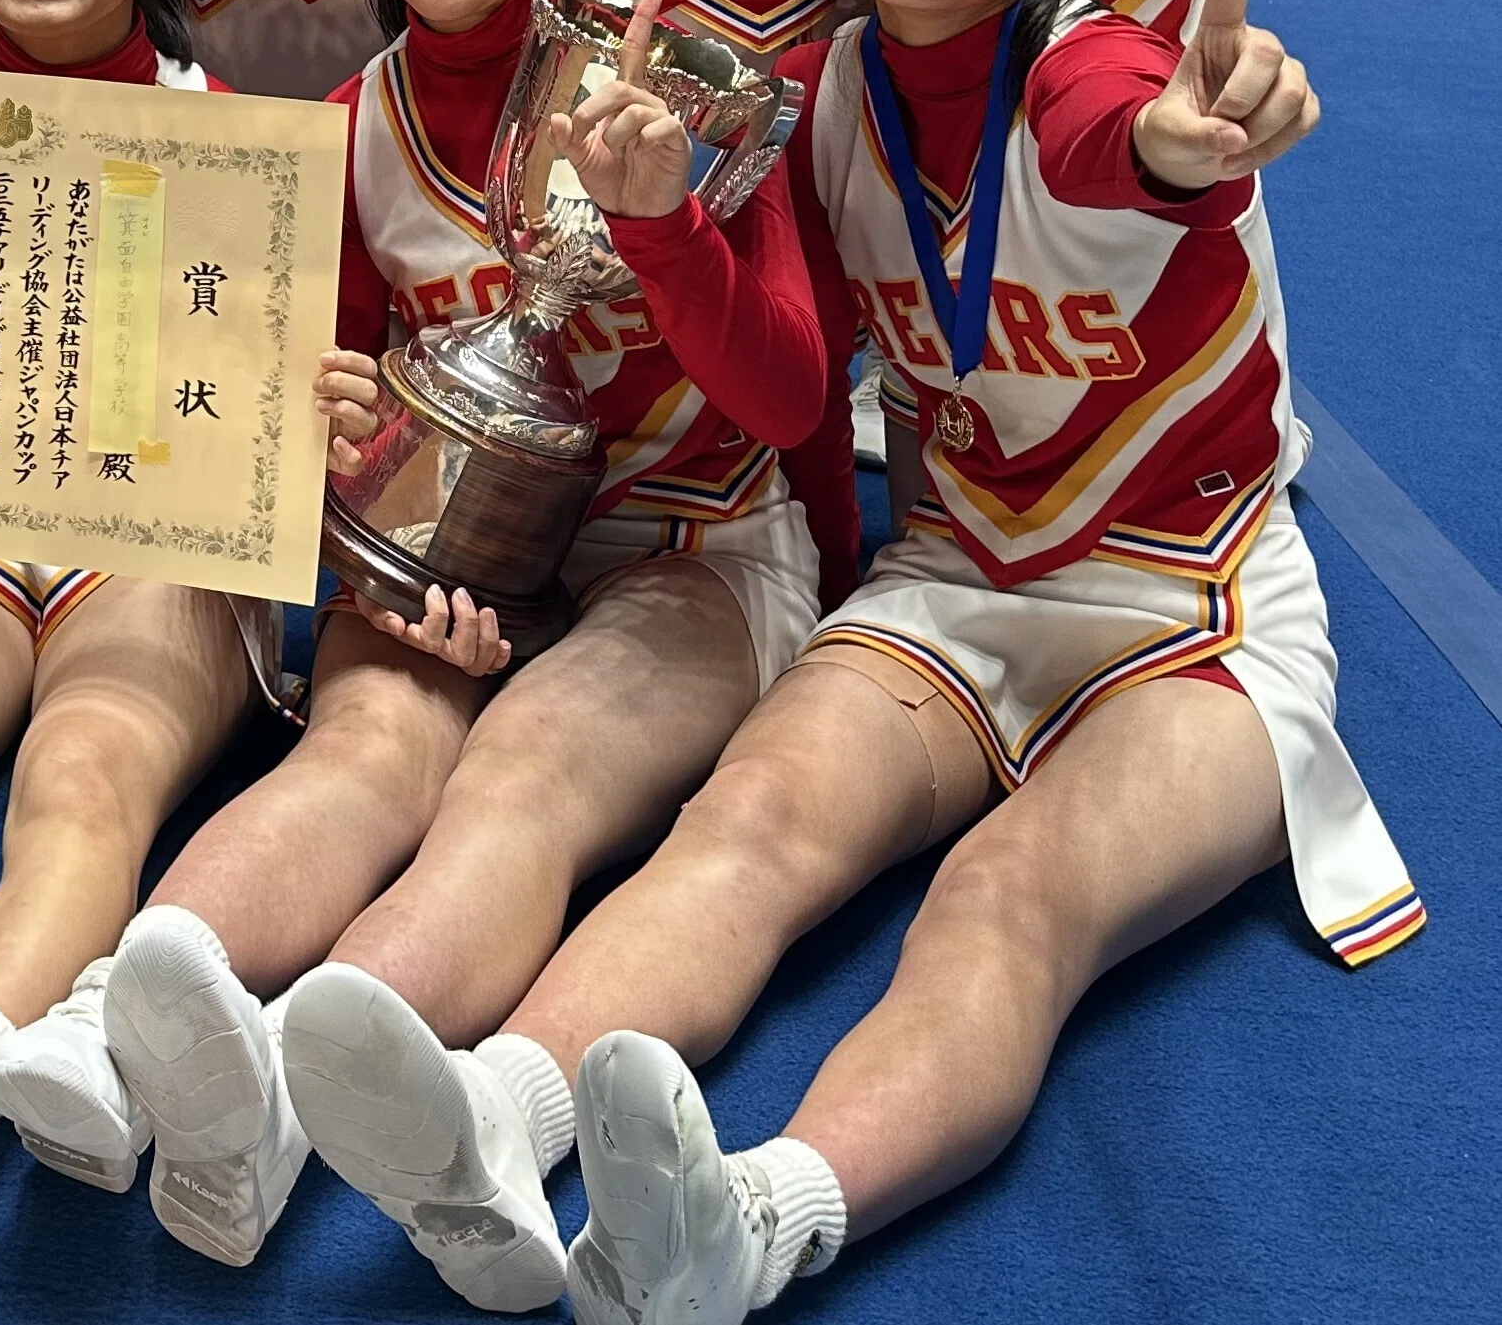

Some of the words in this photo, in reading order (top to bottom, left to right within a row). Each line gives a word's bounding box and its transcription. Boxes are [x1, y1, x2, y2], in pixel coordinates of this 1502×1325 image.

[13, 176, 56, 486] リーディング協会主催ジャパンカップ
[48, 178, 95, 490] あなたがたは公益社団法人日本チア
[174, 260, 229, 420] 賞状
[98, 452, 137, 485] 殿
[192, 1180, 229, 1209] Kaep
